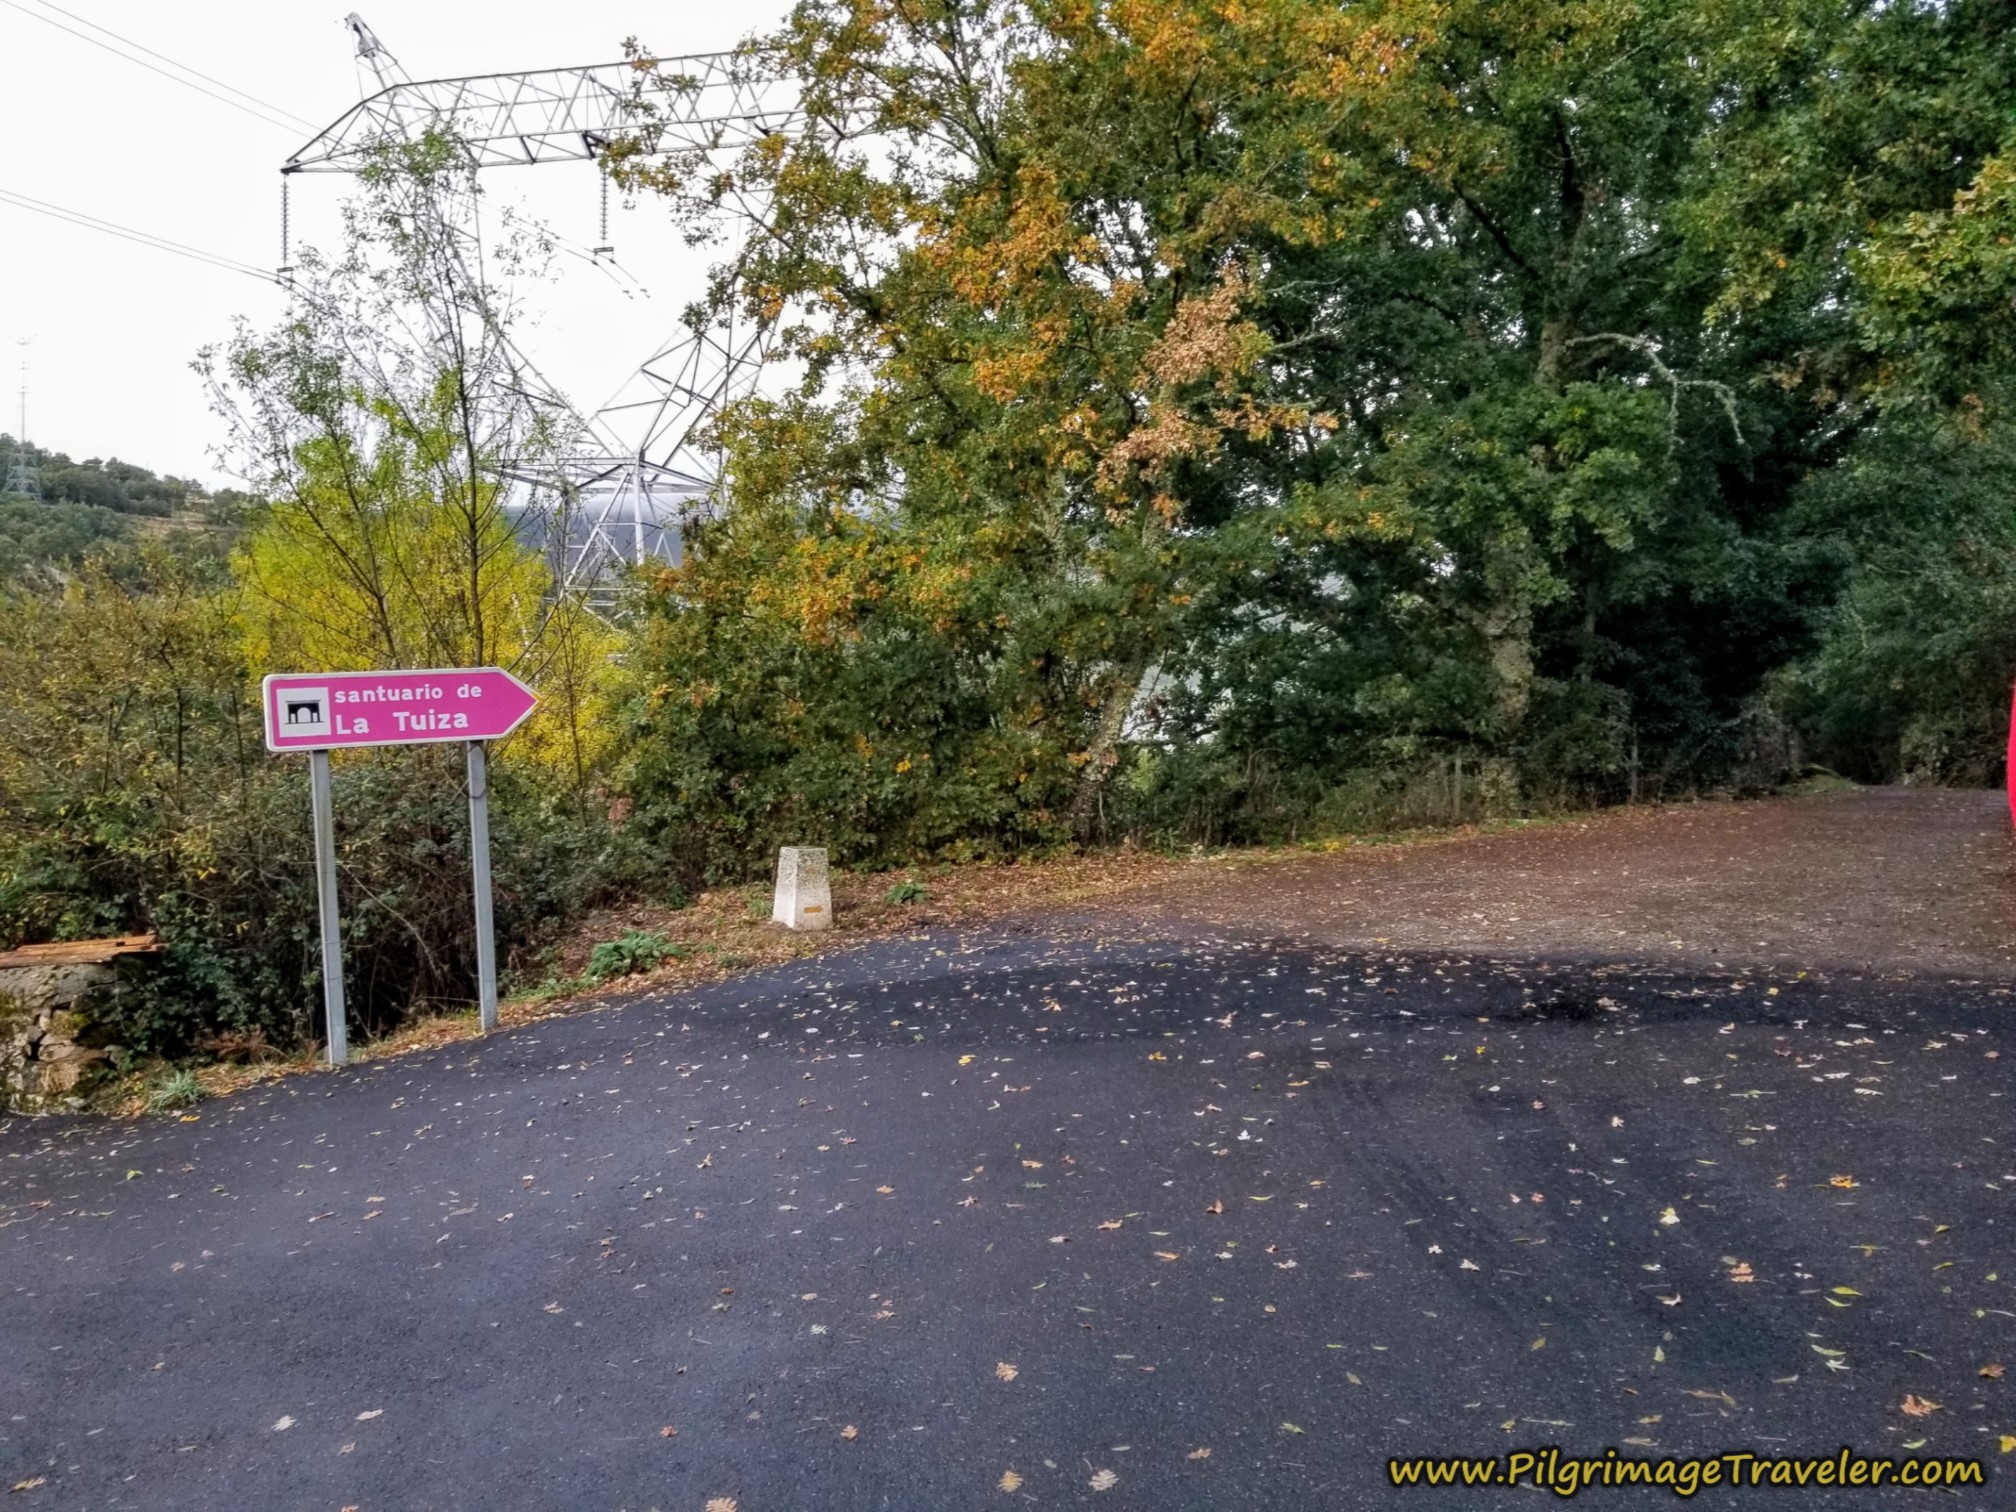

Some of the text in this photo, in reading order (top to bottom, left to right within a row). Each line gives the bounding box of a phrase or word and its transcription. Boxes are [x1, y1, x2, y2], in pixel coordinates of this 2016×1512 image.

[334, 684, 483, 704] santuario de
[335, 709, 469, 735] La Tuiza
